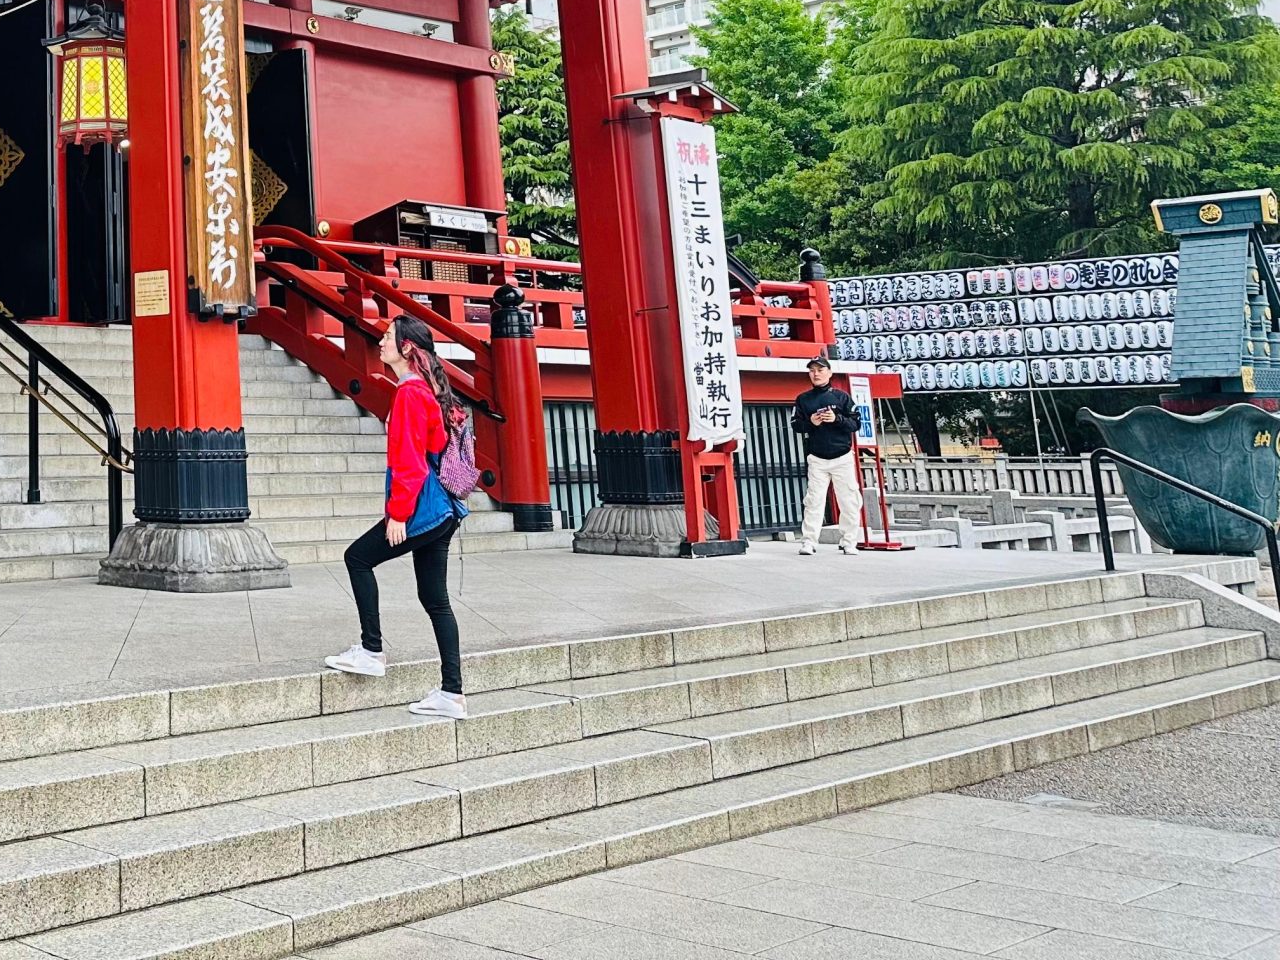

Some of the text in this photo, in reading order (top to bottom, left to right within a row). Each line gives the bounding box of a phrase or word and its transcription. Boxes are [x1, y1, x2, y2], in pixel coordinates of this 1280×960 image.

[437, 214, 467, 228] みくじ
[1080, 259, 1179, 285] 浅草のれん会
[687, 173, 732, 429] 十三まいりお加持執行
[1254, 430, 1271, 447] 納
